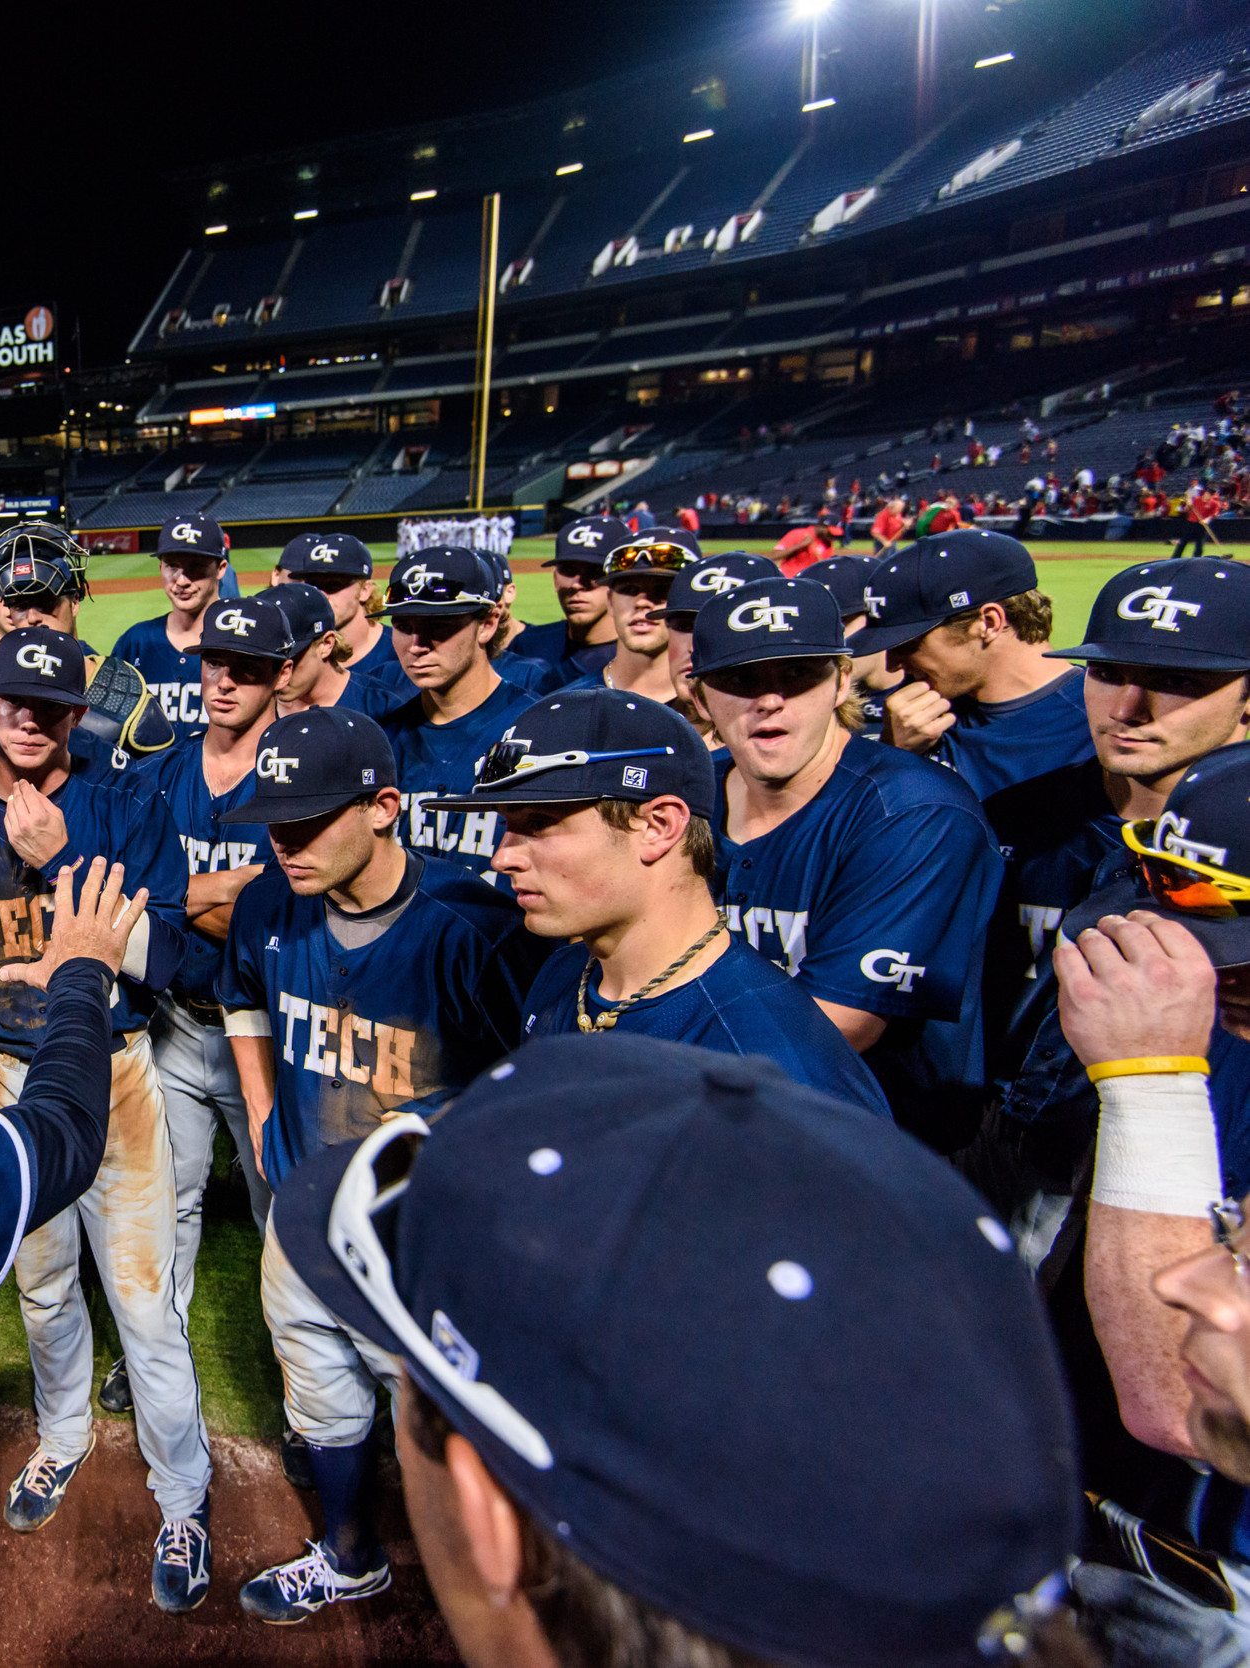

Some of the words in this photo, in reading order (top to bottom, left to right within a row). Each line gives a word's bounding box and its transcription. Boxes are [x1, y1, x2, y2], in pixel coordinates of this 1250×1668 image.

[171, 522, 202, 544] GT
[567, 525, 603, 548] GT
[310, 543, 339, 563] GT
[215, 608, 257, 637] GT
[727, 597, 799, 632] GT
[1117, 585, 1201, 633] GT
[15, 644, 63, 677] GT
[257, 746, 299, 784] GT
[860, 949, 926, 993] GT
[278, 991, 416, 1097] TECH
